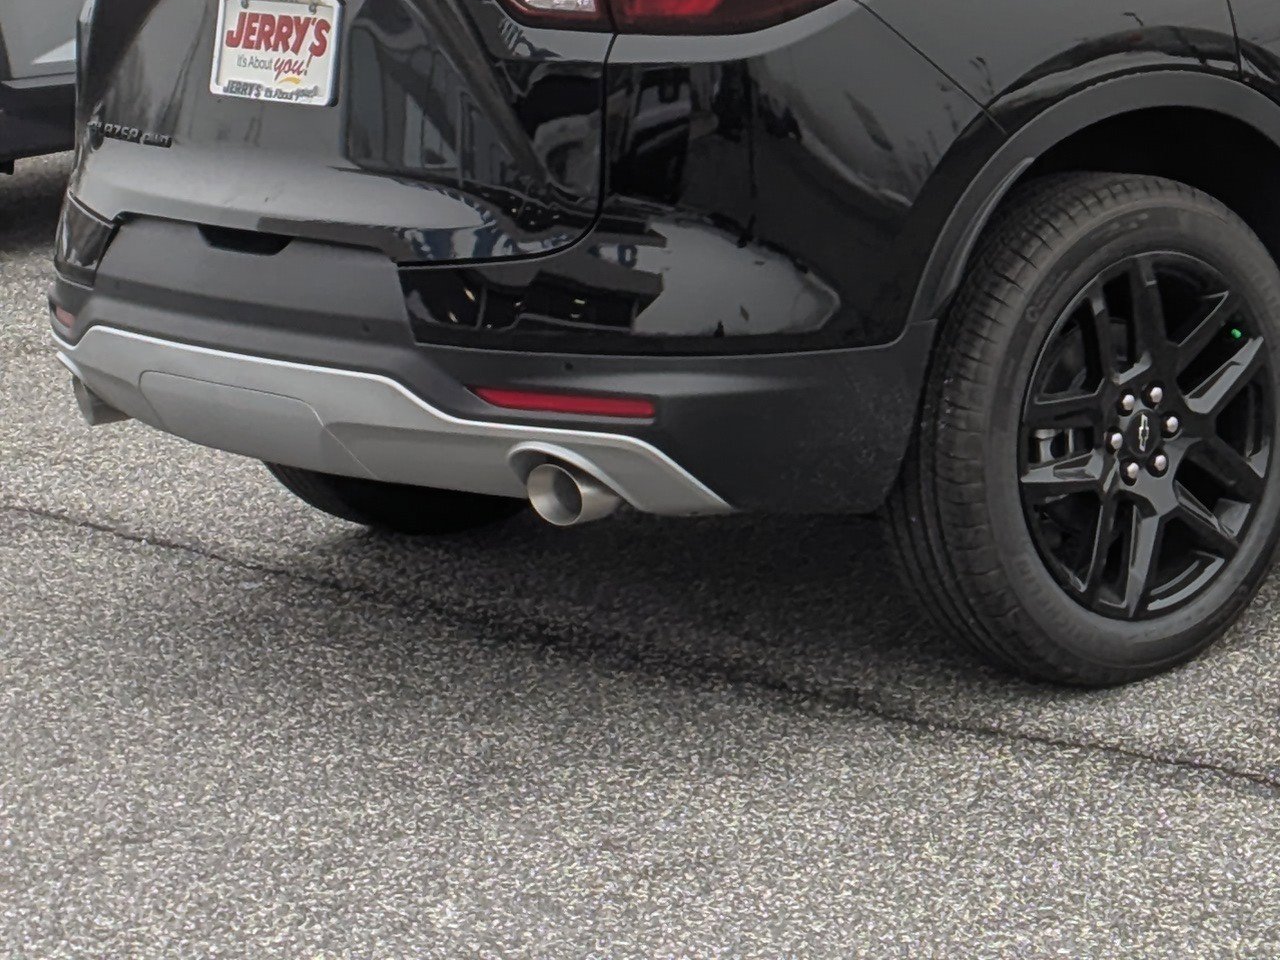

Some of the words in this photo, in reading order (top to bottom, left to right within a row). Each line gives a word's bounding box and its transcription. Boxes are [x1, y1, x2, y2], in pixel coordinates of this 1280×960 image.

[225, 11, 332, 58] JERRY'S
[248, 55, 273, 72] About
[273, 54, 314, 81] you!
